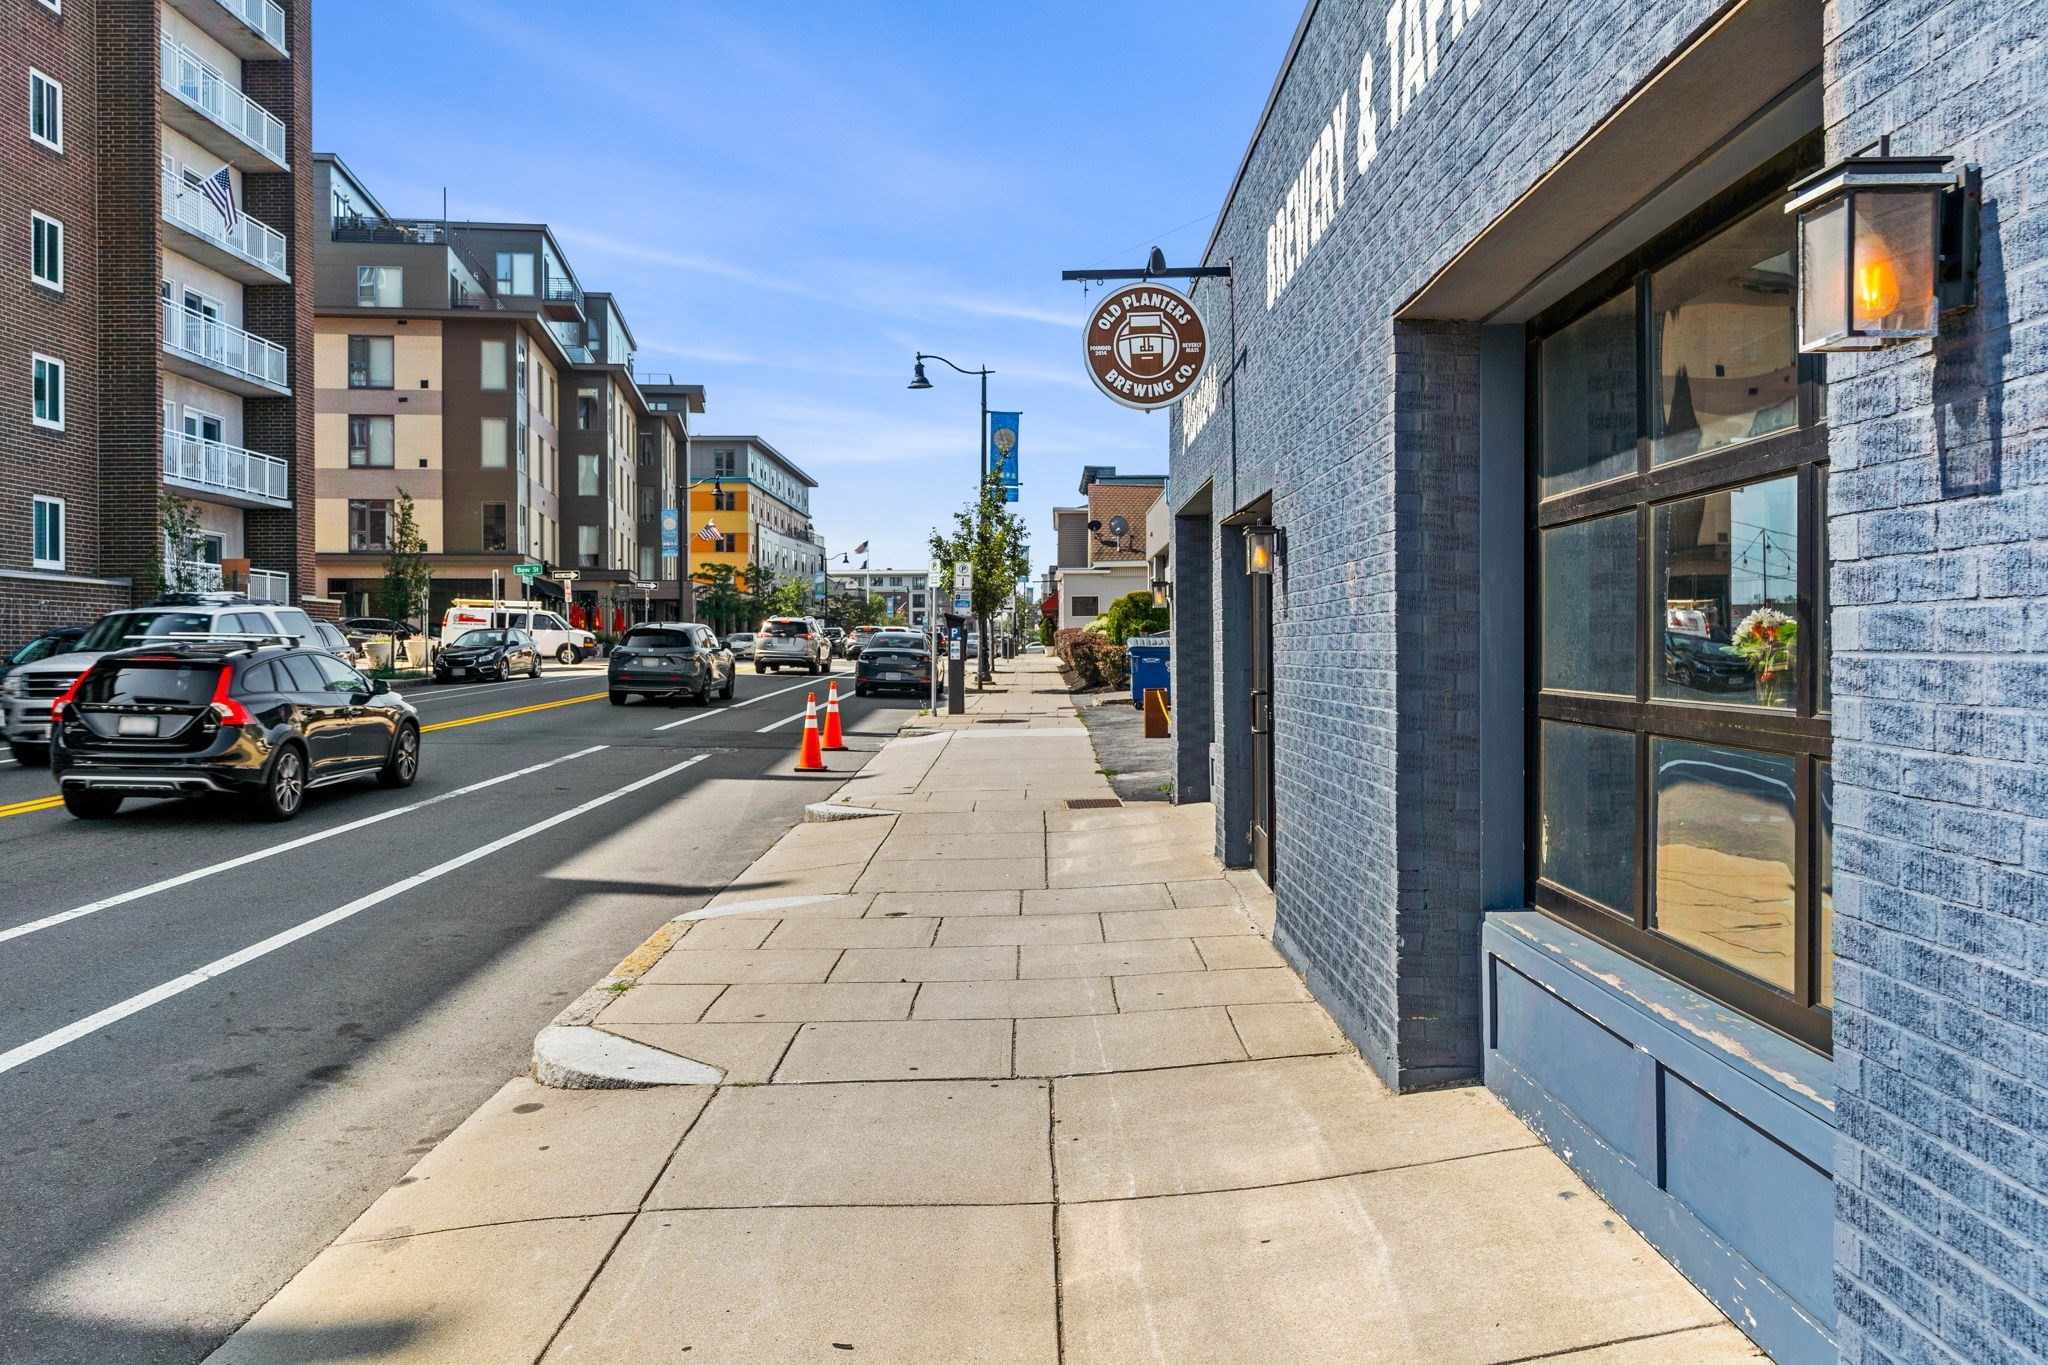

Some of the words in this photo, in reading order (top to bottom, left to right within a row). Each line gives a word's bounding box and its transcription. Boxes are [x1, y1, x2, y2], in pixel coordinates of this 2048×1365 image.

[1266, 88, 1349, 312] BREWERY
[1357, 51, 1378, 176] &
[1097, 303, 1122, 330] OLD
[1121, 292, 1192, 325] PLANTERS
[1104, 369, 1174, 398] BREWING
[1174, 363, 1196, 384] CO.
[952, 628, 958, 637] P
